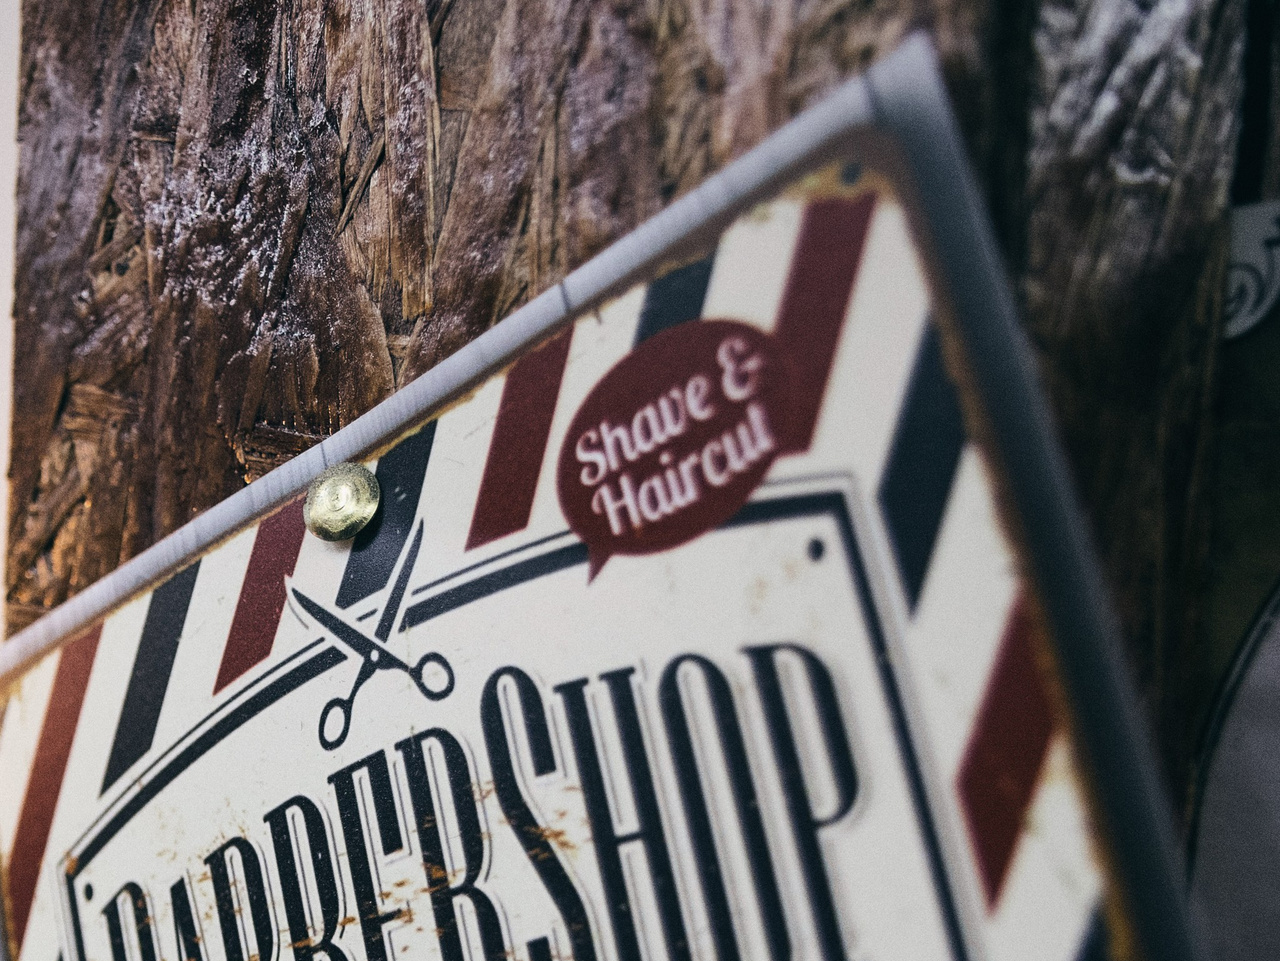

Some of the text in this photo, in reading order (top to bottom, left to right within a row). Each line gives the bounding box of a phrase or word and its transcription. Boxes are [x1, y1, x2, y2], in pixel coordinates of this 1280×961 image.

[575, 336, 763, 486] Shave &
[591, 402, 774, 536] Haircut
